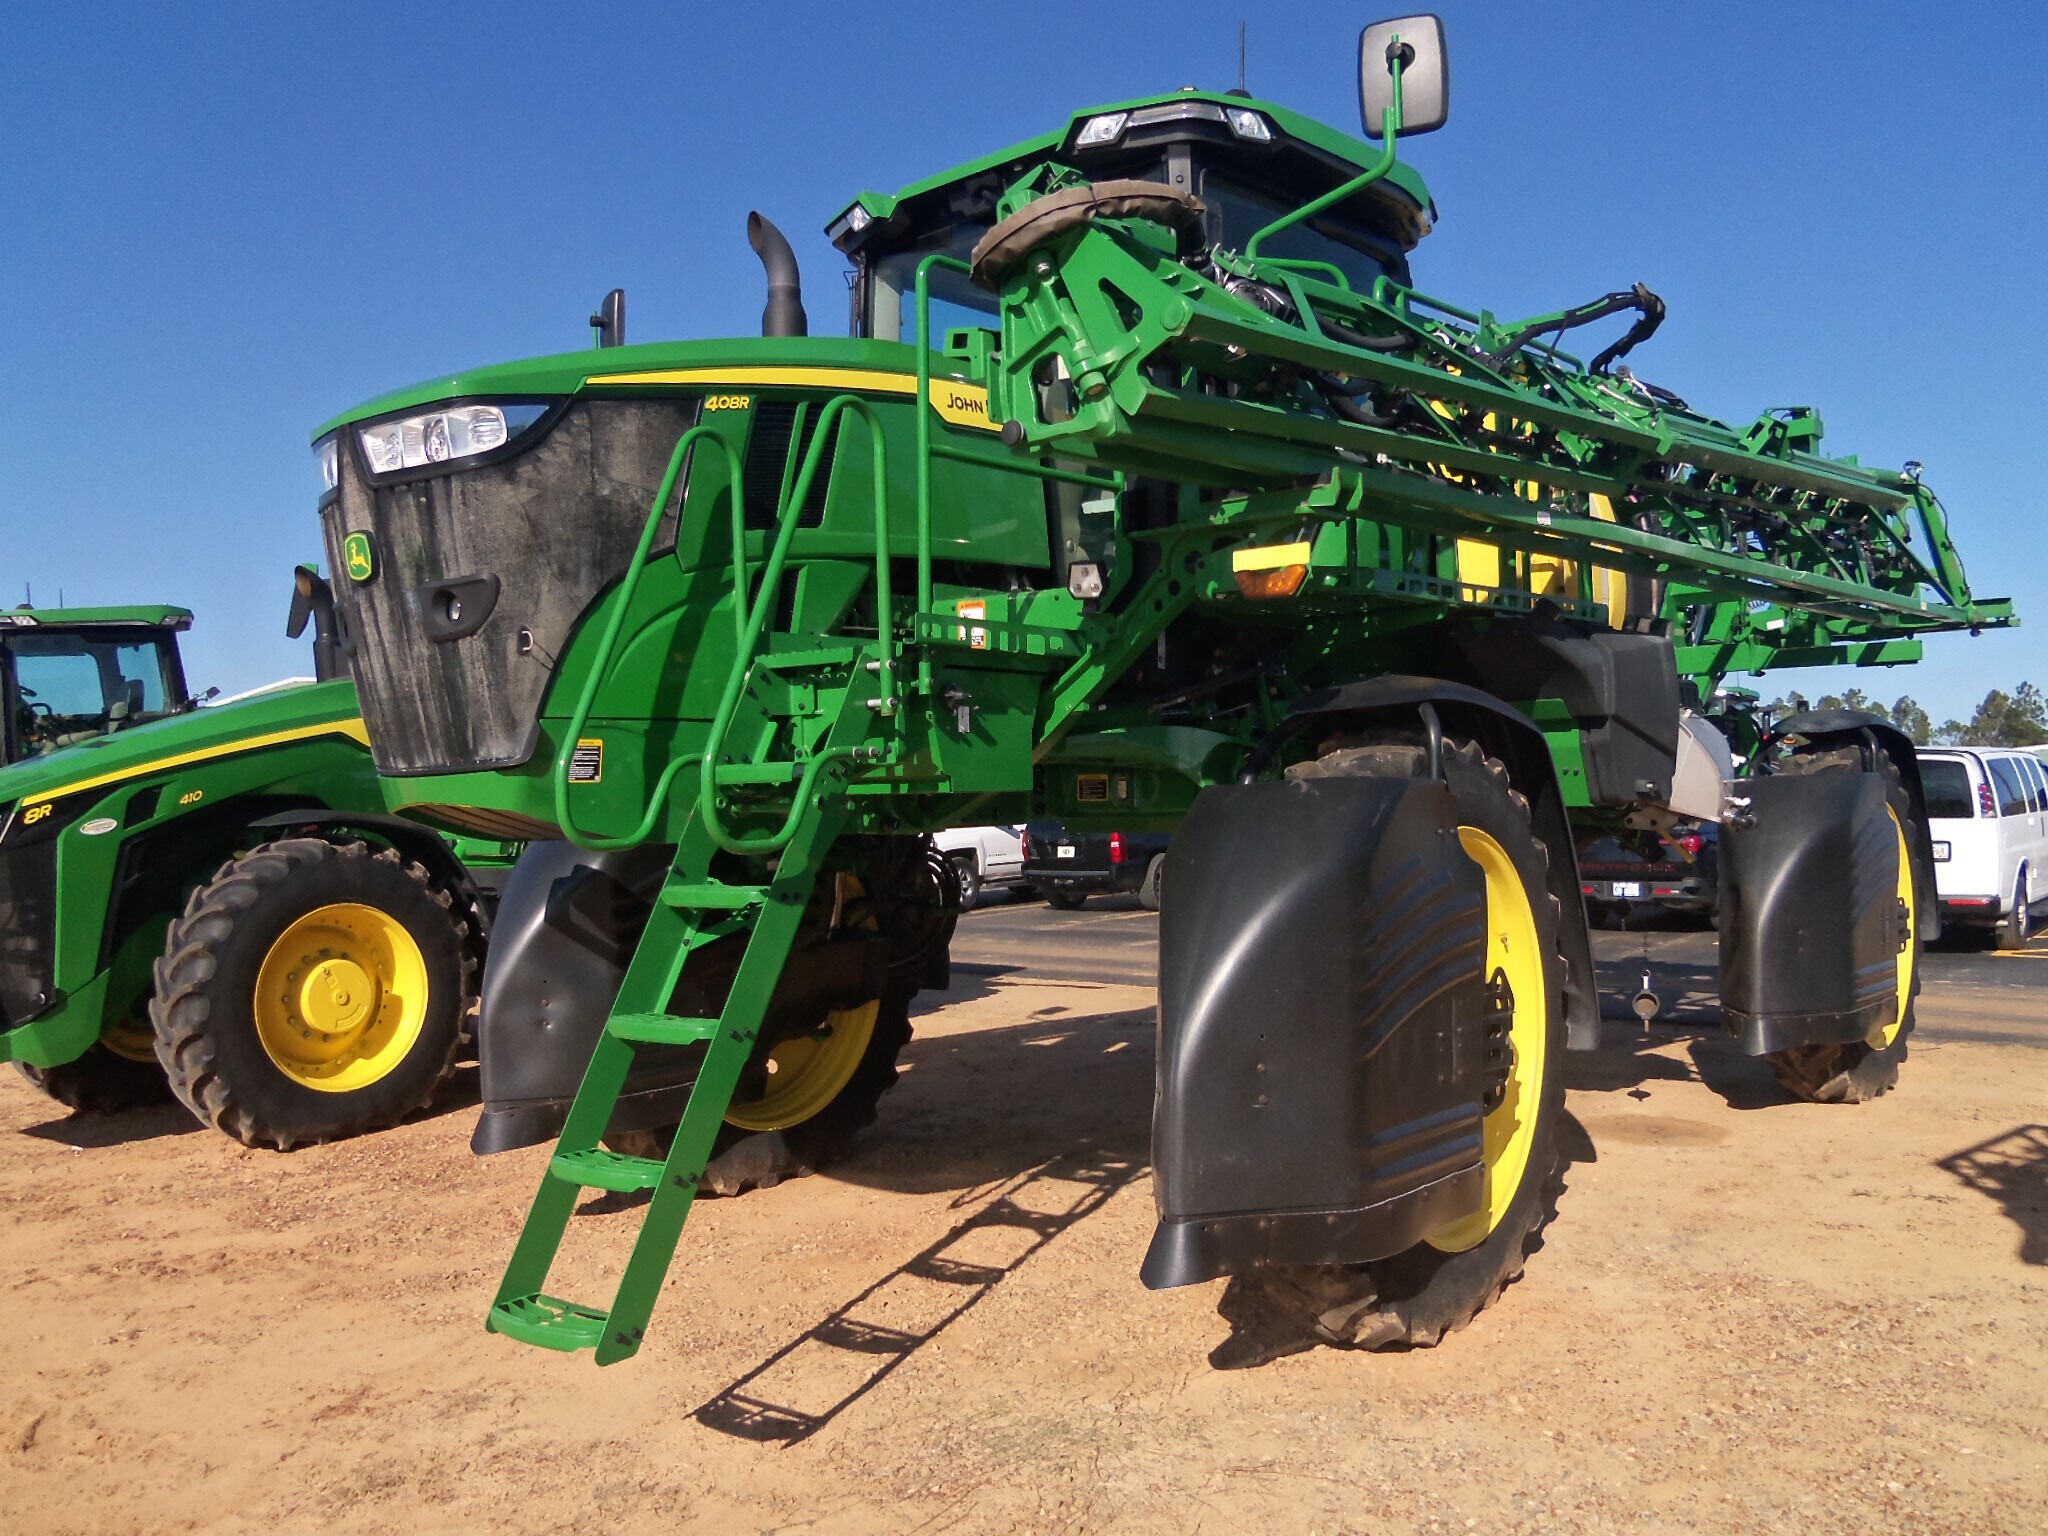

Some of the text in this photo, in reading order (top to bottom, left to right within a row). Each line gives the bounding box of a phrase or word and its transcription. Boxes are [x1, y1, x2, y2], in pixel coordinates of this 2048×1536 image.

[705, 396, 750, 411] 408R
[947, 393, 984, 414] JOHN
[179, 790, 203, 804] 410
[23, 804, 53, 825] 8R
